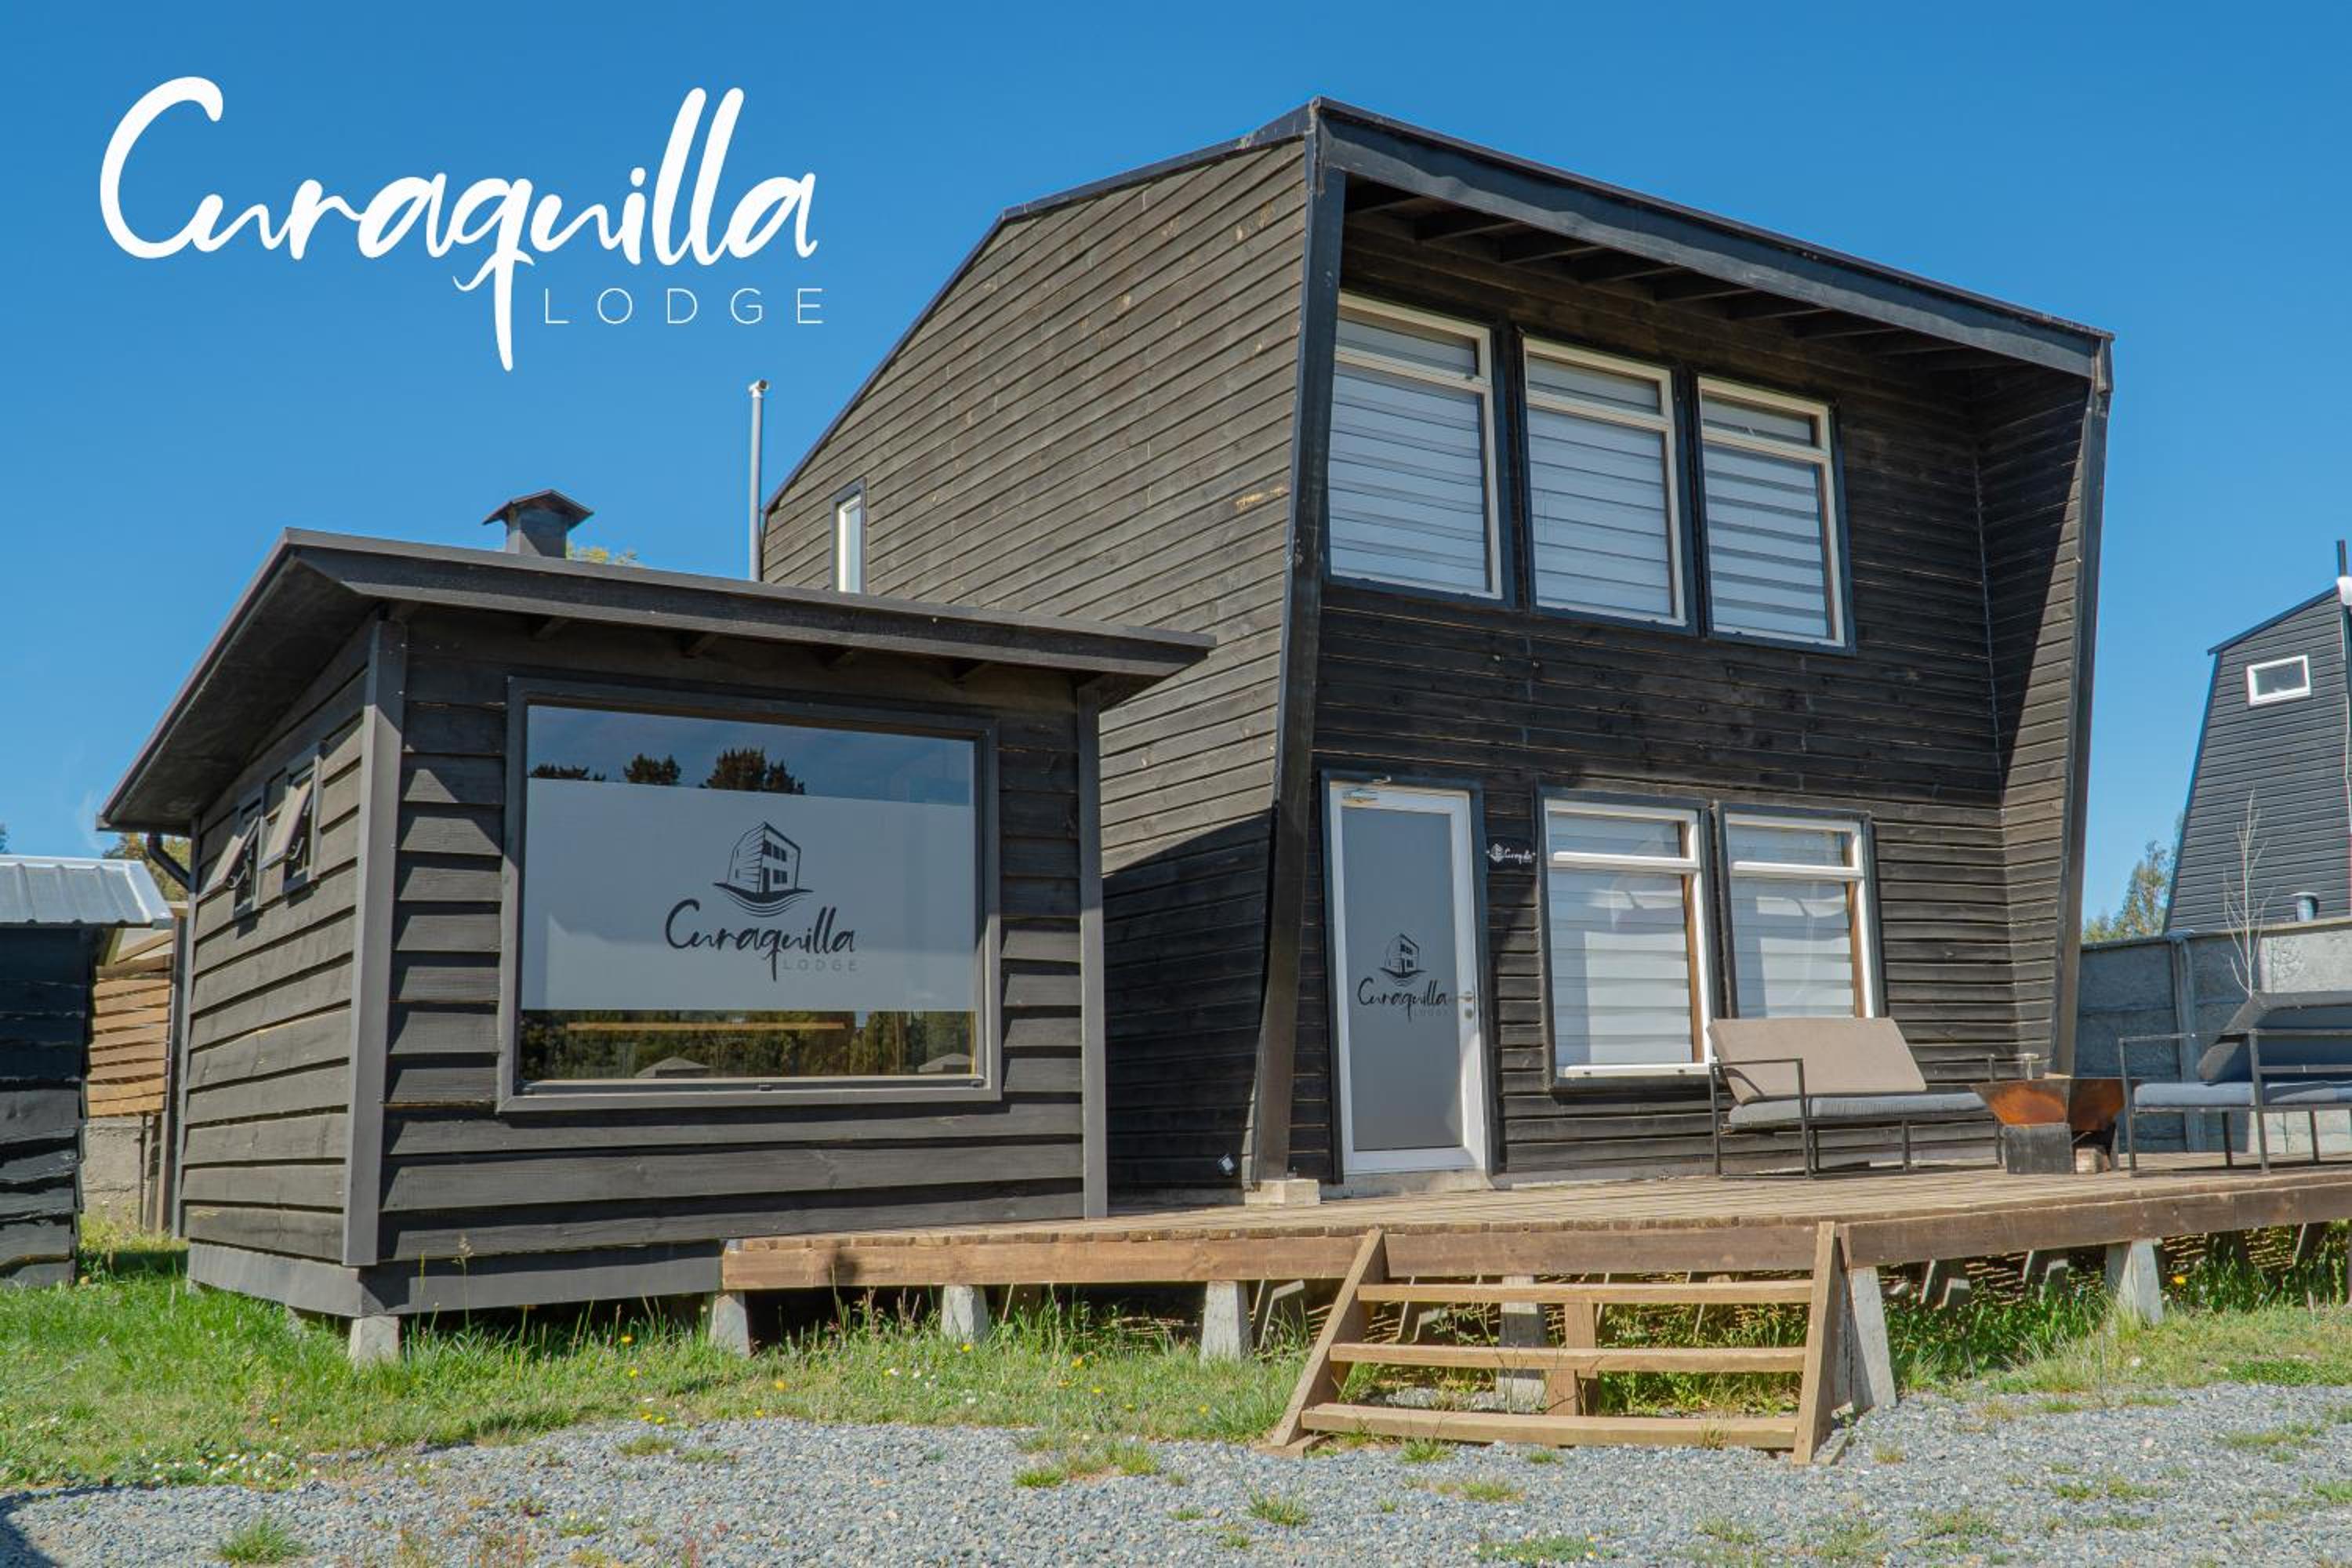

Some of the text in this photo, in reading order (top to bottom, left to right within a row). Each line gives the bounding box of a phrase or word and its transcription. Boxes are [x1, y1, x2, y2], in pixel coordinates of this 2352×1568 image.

[665, 898, 856, 982] Curaquilla
[782, 959, 858, 972] LODGE
[1357, 976, 1448, 1022] Curaquilla
